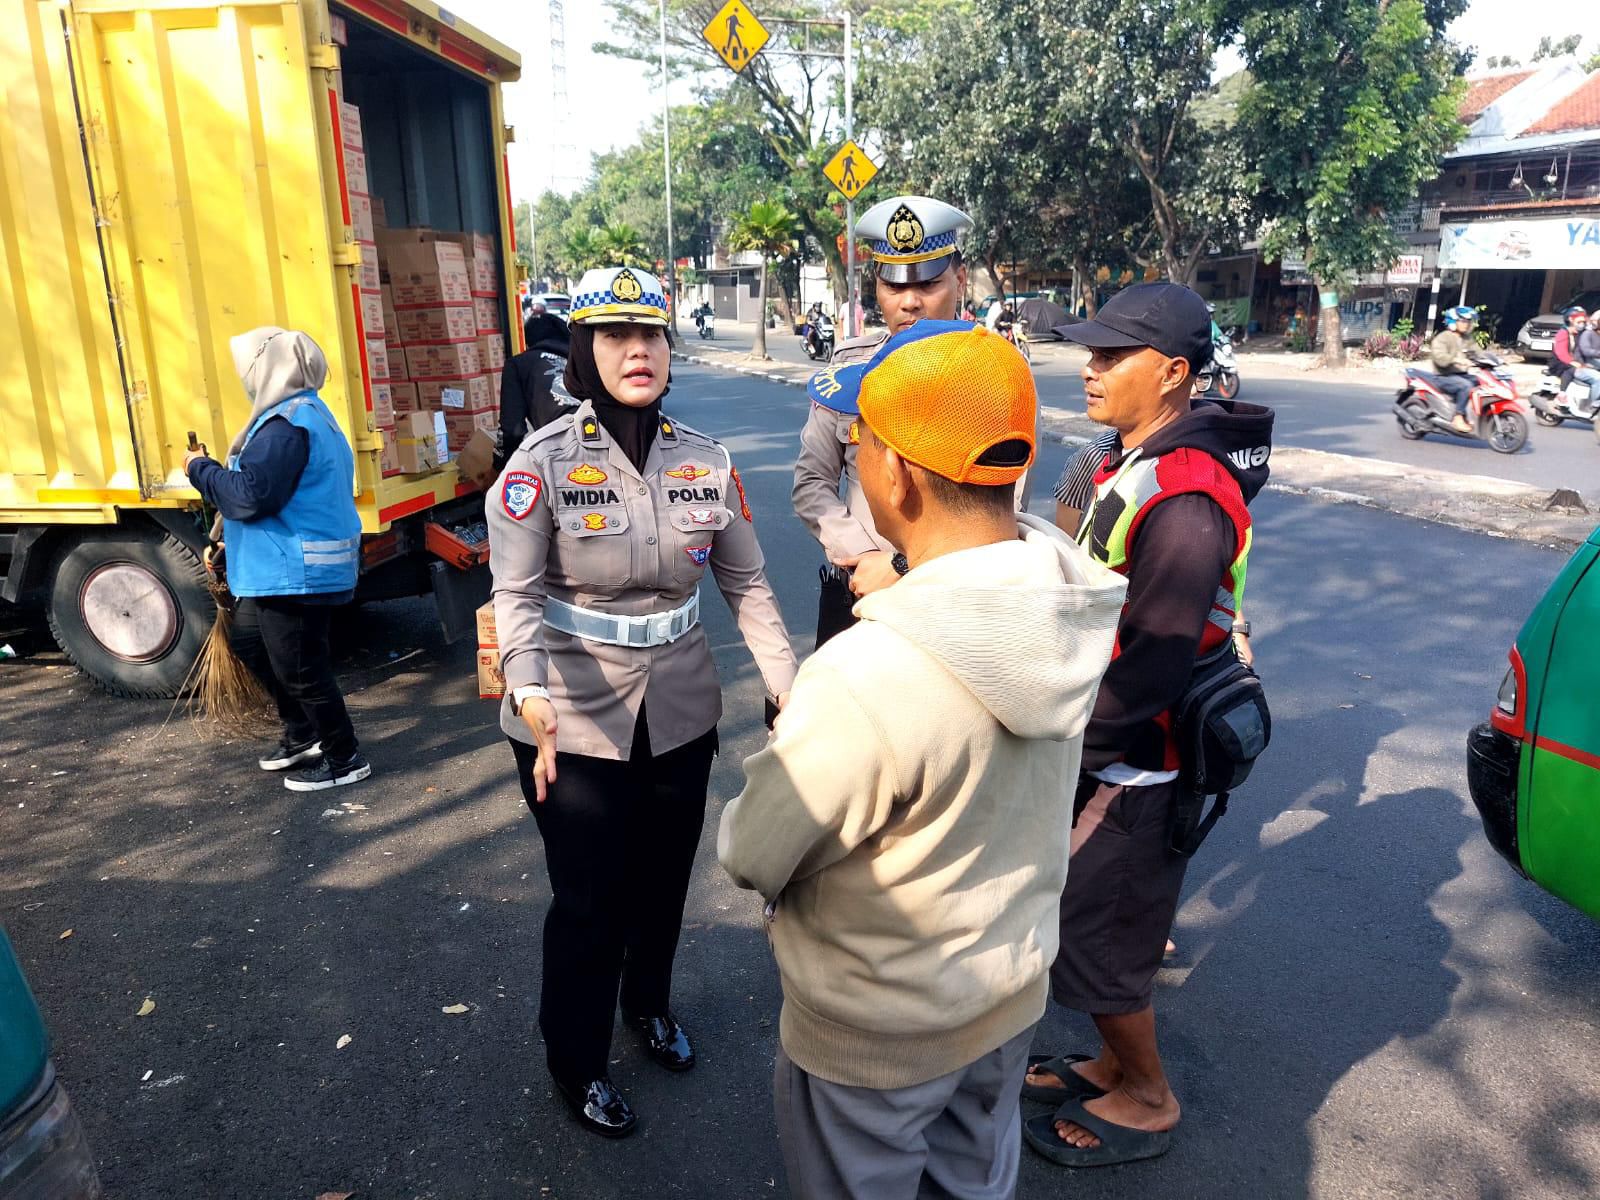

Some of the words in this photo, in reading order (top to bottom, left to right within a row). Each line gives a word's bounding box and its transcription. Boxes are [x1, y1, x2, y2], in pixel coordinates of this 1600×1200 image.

[1340, 300, 1384, 315] HILIPS
[561, 488, 620, 507] WIDIA
[667, 487, 720, 504] POLRI
